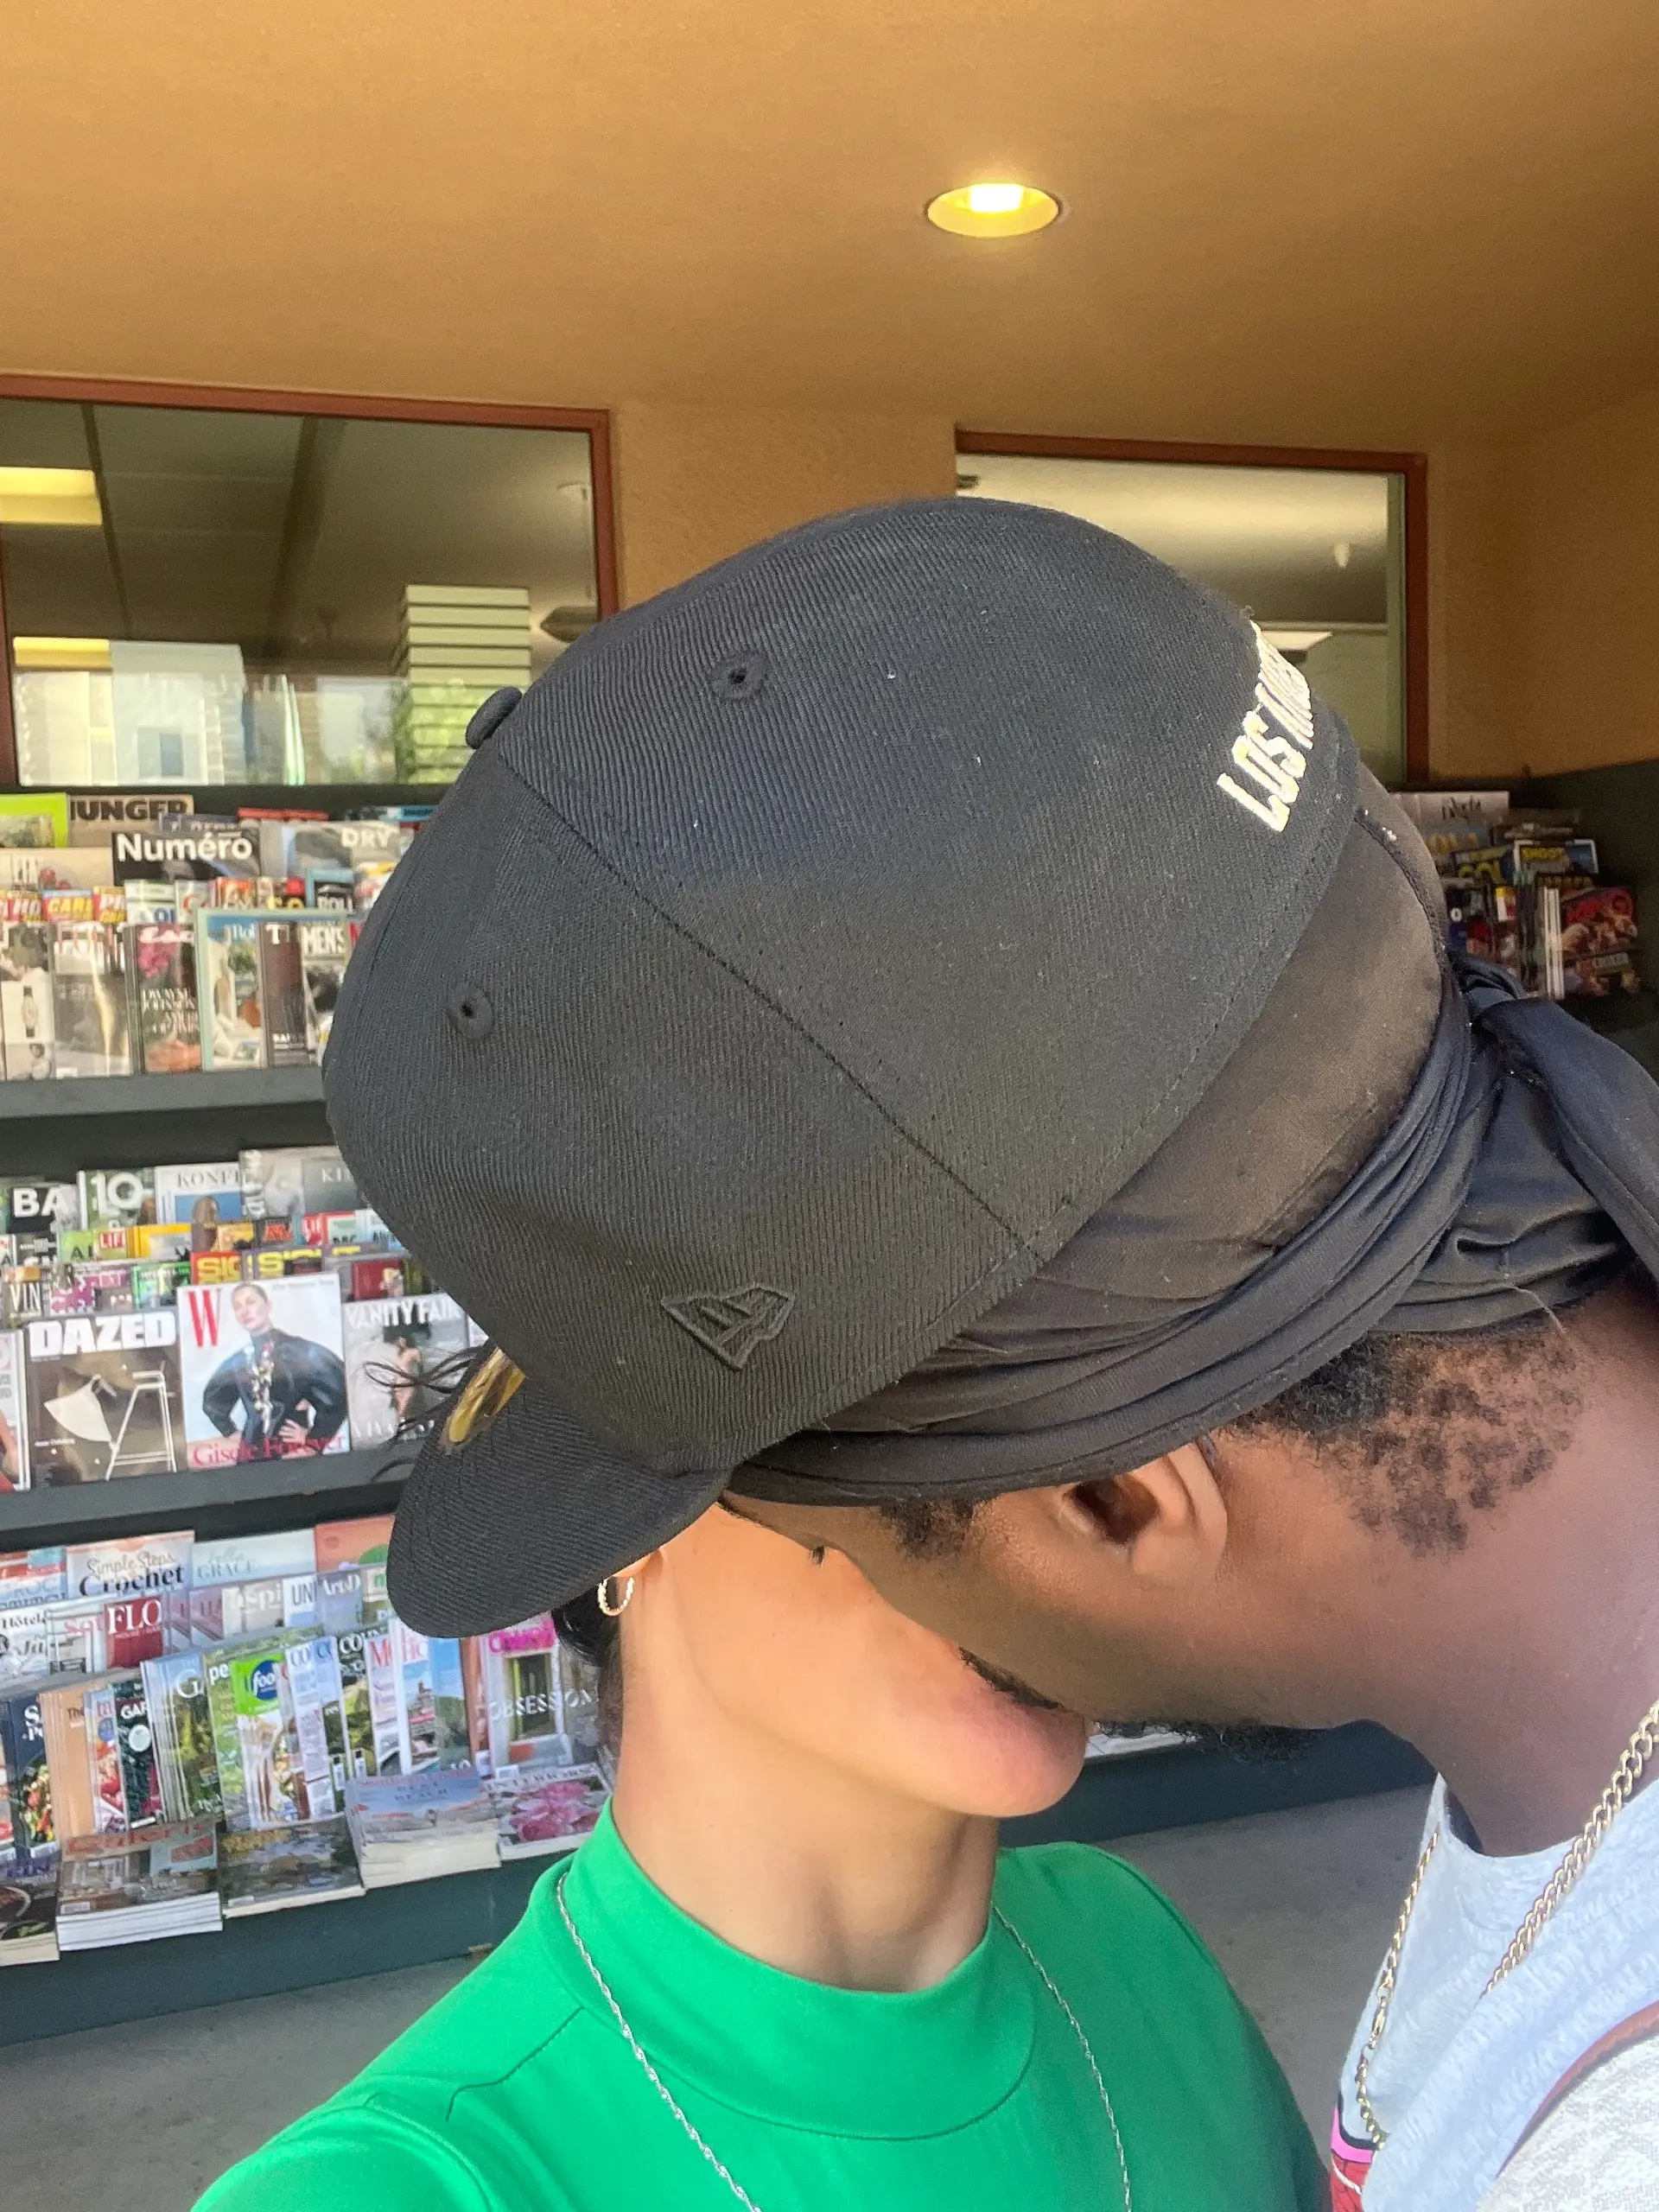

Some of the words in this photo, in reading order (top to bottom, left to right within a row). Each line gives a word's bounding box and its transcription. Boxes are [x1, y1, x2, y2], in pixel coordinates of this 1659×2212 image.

[116, 831, 253, 862] Numéro
[188, 1288, 221, 1349] W
[346, 1299, 414, 1329] VANITY
[29, 1312, 175, 1357] DAZED
[193, 1441, 257, 1467] Gisele
[79, 1564, 184, 1597] Crochet
